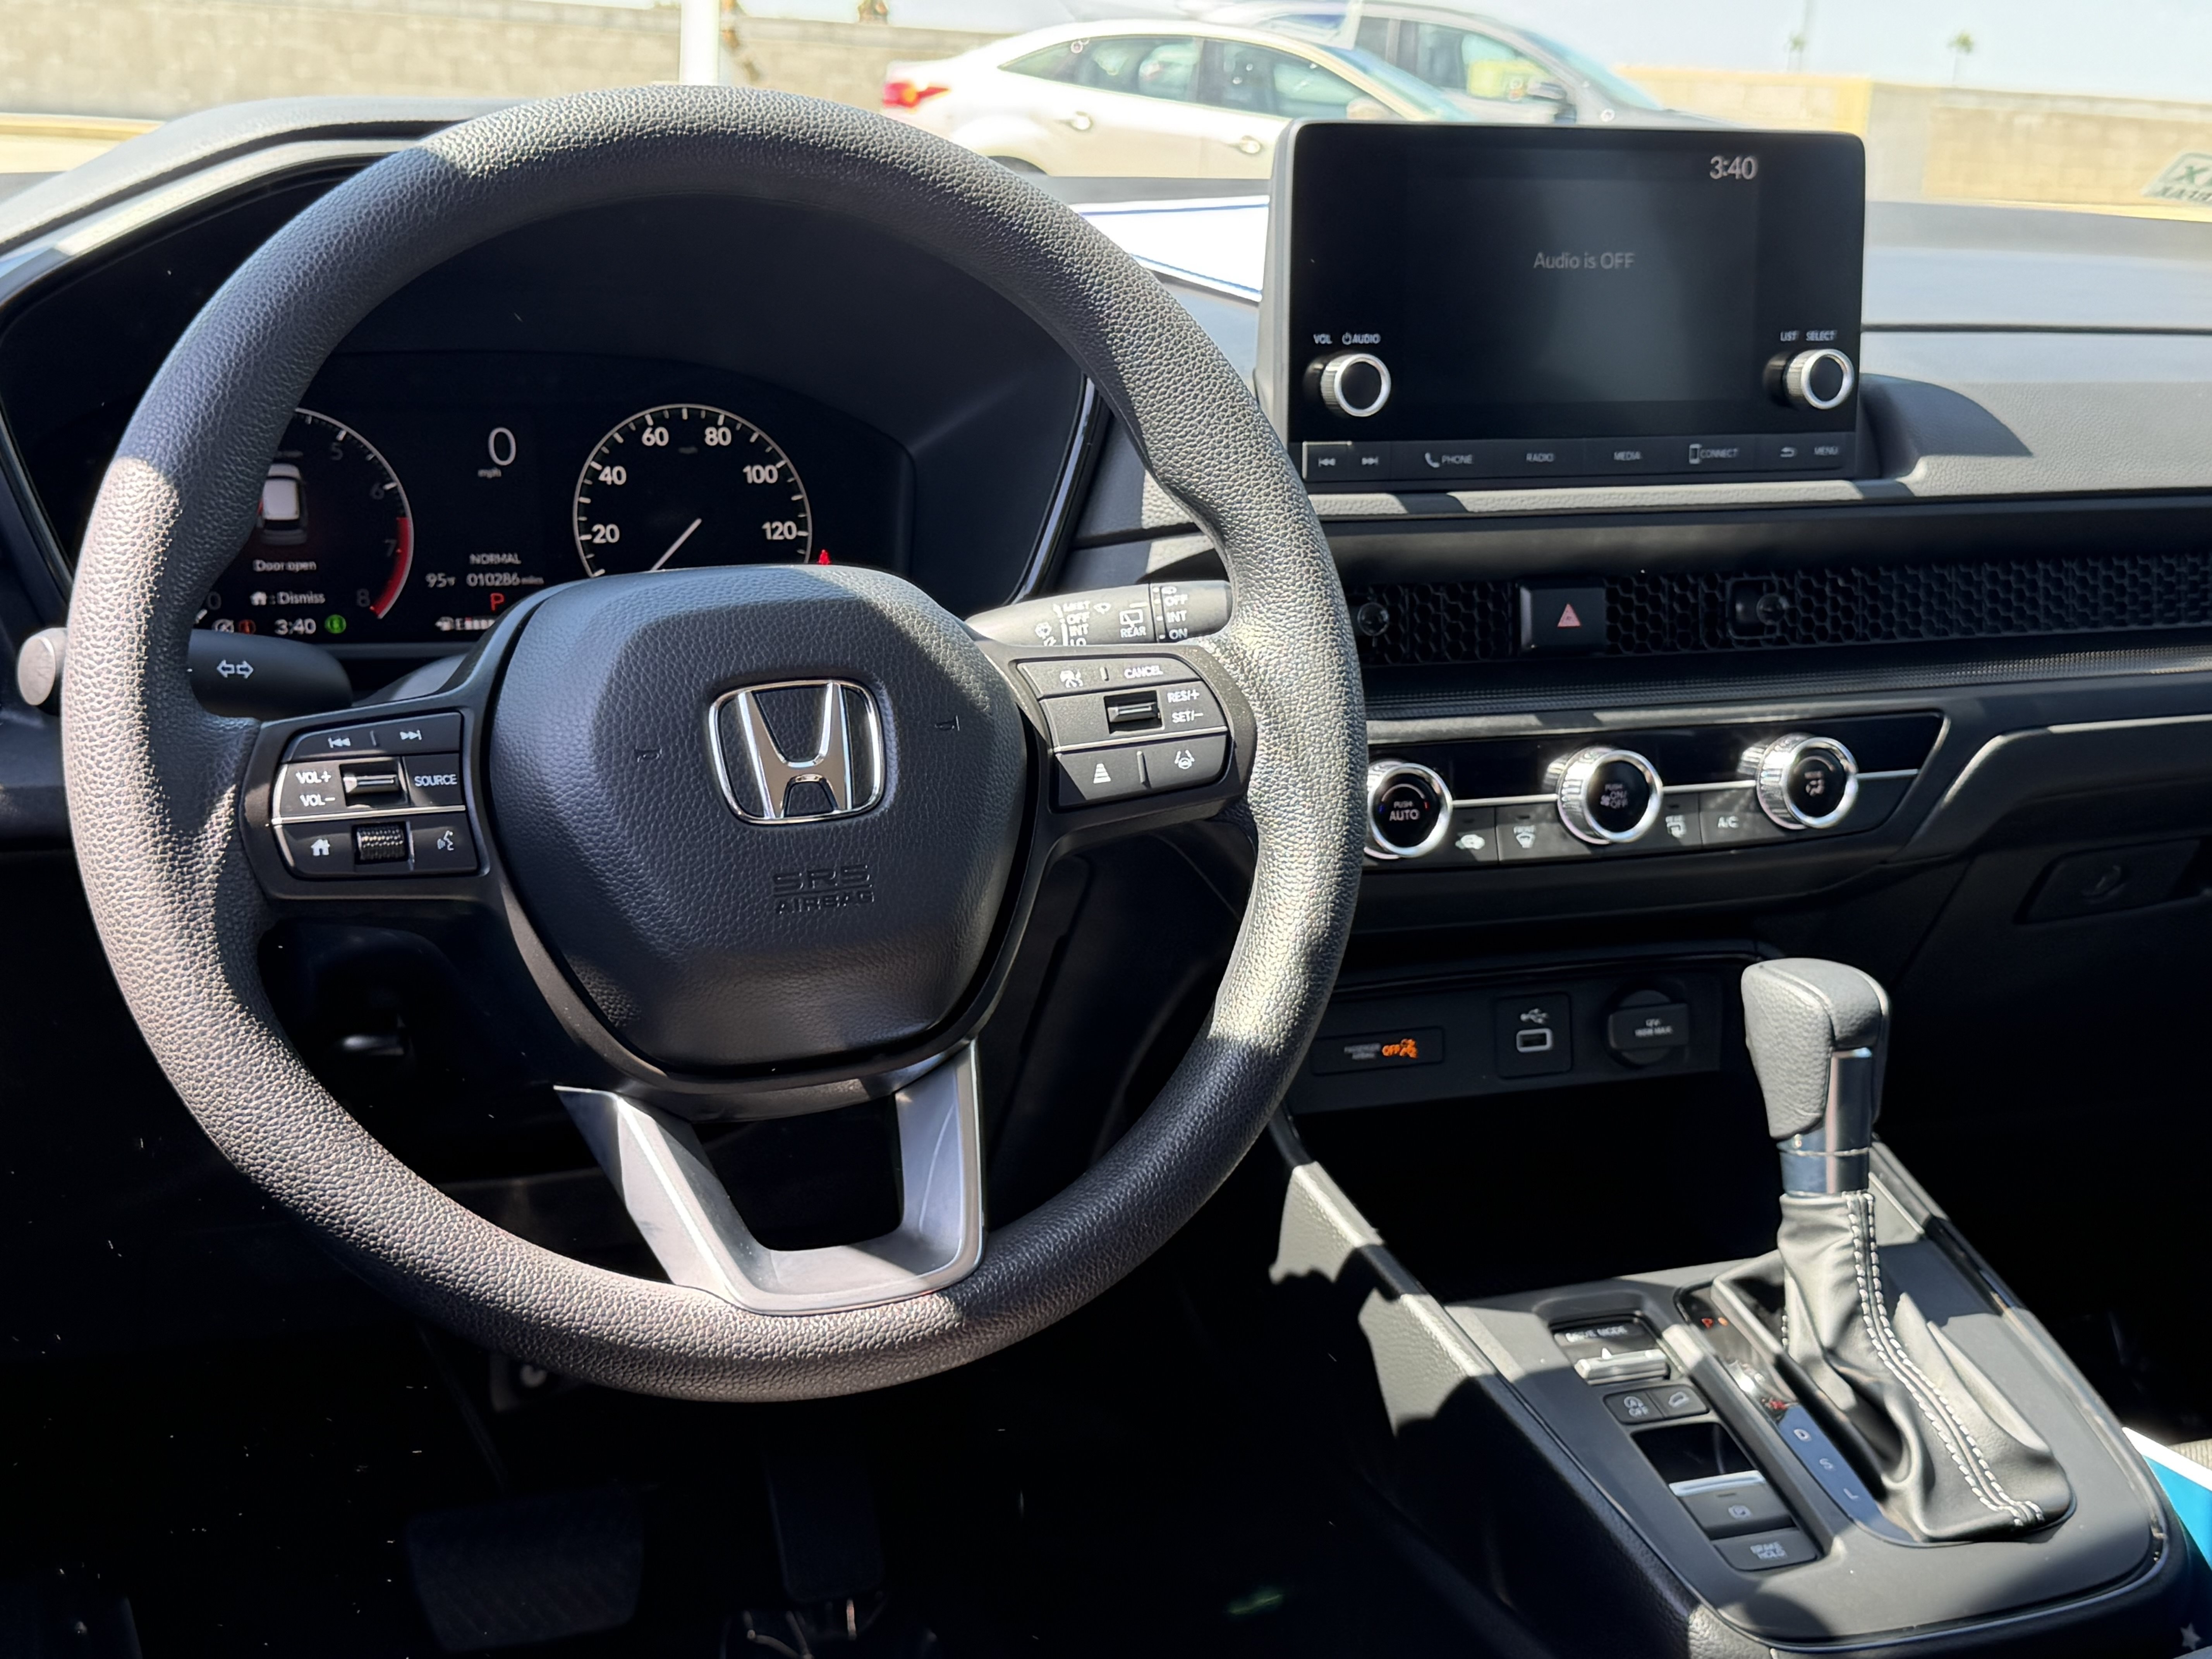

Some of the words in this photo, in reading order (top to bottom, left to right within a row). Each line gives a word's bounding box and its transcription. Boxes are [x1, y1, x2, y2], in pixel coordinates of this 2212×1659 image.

[1709, 156, 1759, 180] 3:40
[1534, 252, 1580, 269] Audio
[1584, 252, 1596, 269] is
[1600, 252, 1635, 269] OFF
[1314, 333, 1332, 344] VOL
[1352, 333, 1381, 344] AUDIO
[1780, 330, 1800, 341] LIST
[1806, 330, 1837, 341] SELECT
[642, 427, 669, 446] 60
[705, 427, 732, 446] 80
[330, 442, 343, 460] 5
[488, 427, 516, 466] 0
[1700, 448, 1740, 458] CONNECT
[1814, 446, 1838, 455] MENU
[1442, 455, 1473, 464] PHONE
[1526, 453, 1554, 462] RADIO
[1614, 451, 1642, 460] MEDIA
[599, 466, 627, 485] 40
[743, 465, 778, 484] 100
[369, 482, 385, 500] 6
[591, 524, 620, 543] 20
[762, 521, 797, 540] 120
[469, 553, 521, 564] NORMAL
[253, 560, 284, 572] Door
[286, 561, 317, 573] open
[466, 572, 520, 586] 010286
[277, 591, 325, 605] Dismiss
[357, 588, 370, 607] 8
[490, 593, 505, 611] P
[1164, 594, 1188, 606] OFF
[1066, 611, 1090, 624] OFF
[1166, 610, 1187, 623] INT
[274, 618, 316, 635] 3:40
[1069, 623, 1089, 637] INT
[1120, 626, 1146, 638] REAR
[1169, 628, 1188, 640] ON
[1124, 665, 1163, 679] CANCEL
[296, 771, 331, 784] VOL+
[414, 775, 458, 787] SOURCE
[1389, 809, 1420, 821] AUTO
[1718, 816, 1739, 828] A/C
[1819, 1458, 1836, 1471] S
[1844, 1488, 1858, 1499] L
